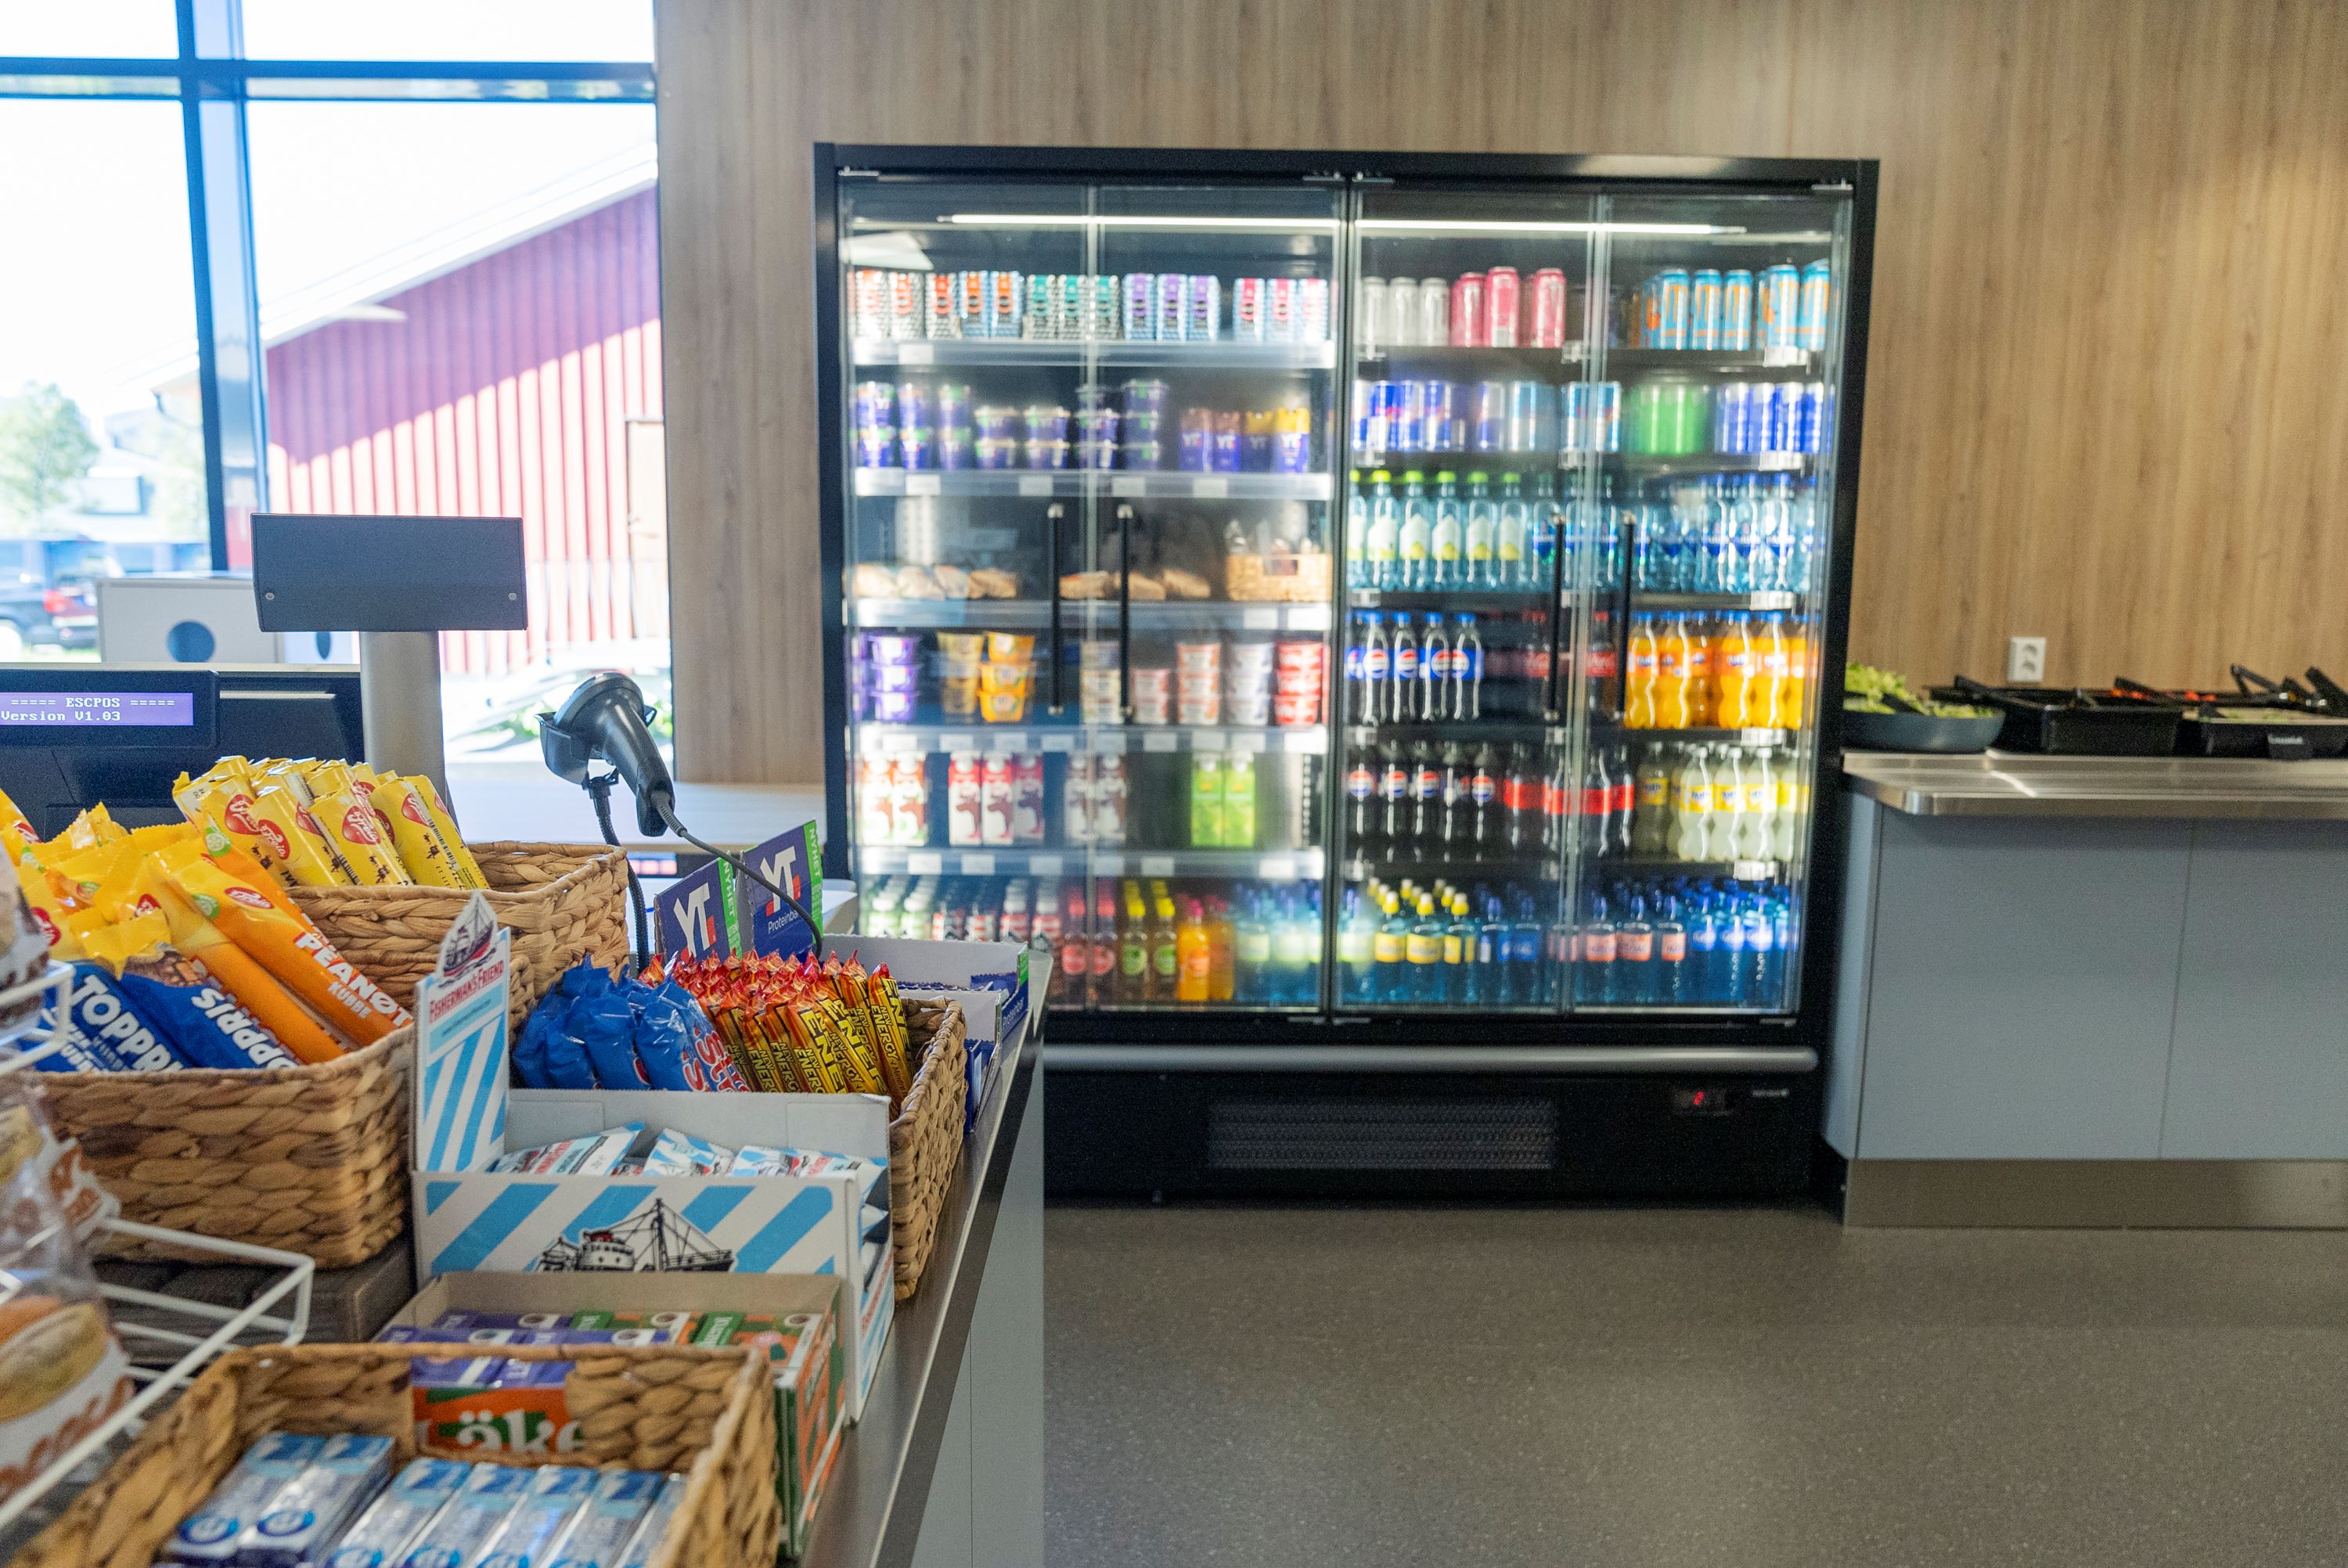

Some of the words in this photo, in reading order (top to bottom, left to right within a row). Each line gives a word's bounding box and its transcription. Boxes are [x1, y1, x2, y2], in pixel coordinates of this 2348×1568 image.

[65, 697, 121, 708] ESCPOS
[1, 710, 66, 721] Version
[74, 710, 121, 721] V1.03
[808, 828, 821, 877] NYHET
[722, 861, 736, 917] NYHET
[760, 846, 797, 913] YT
[673, 882, 711, 958] YT
[768, 910, 801, 934] Proteinba
[855, 1007, 870, 1030] NEW
[879, 1005, 893, 1027] NEW
[830, 1033, 848, 1052] NEW
[870, 1005, 899, 1058] ENERGY
[758, 1049, 776, 1071] NEW
[779, 1042, 794, 1063] NEW
[805, 1048, 822, 1070] NEW
